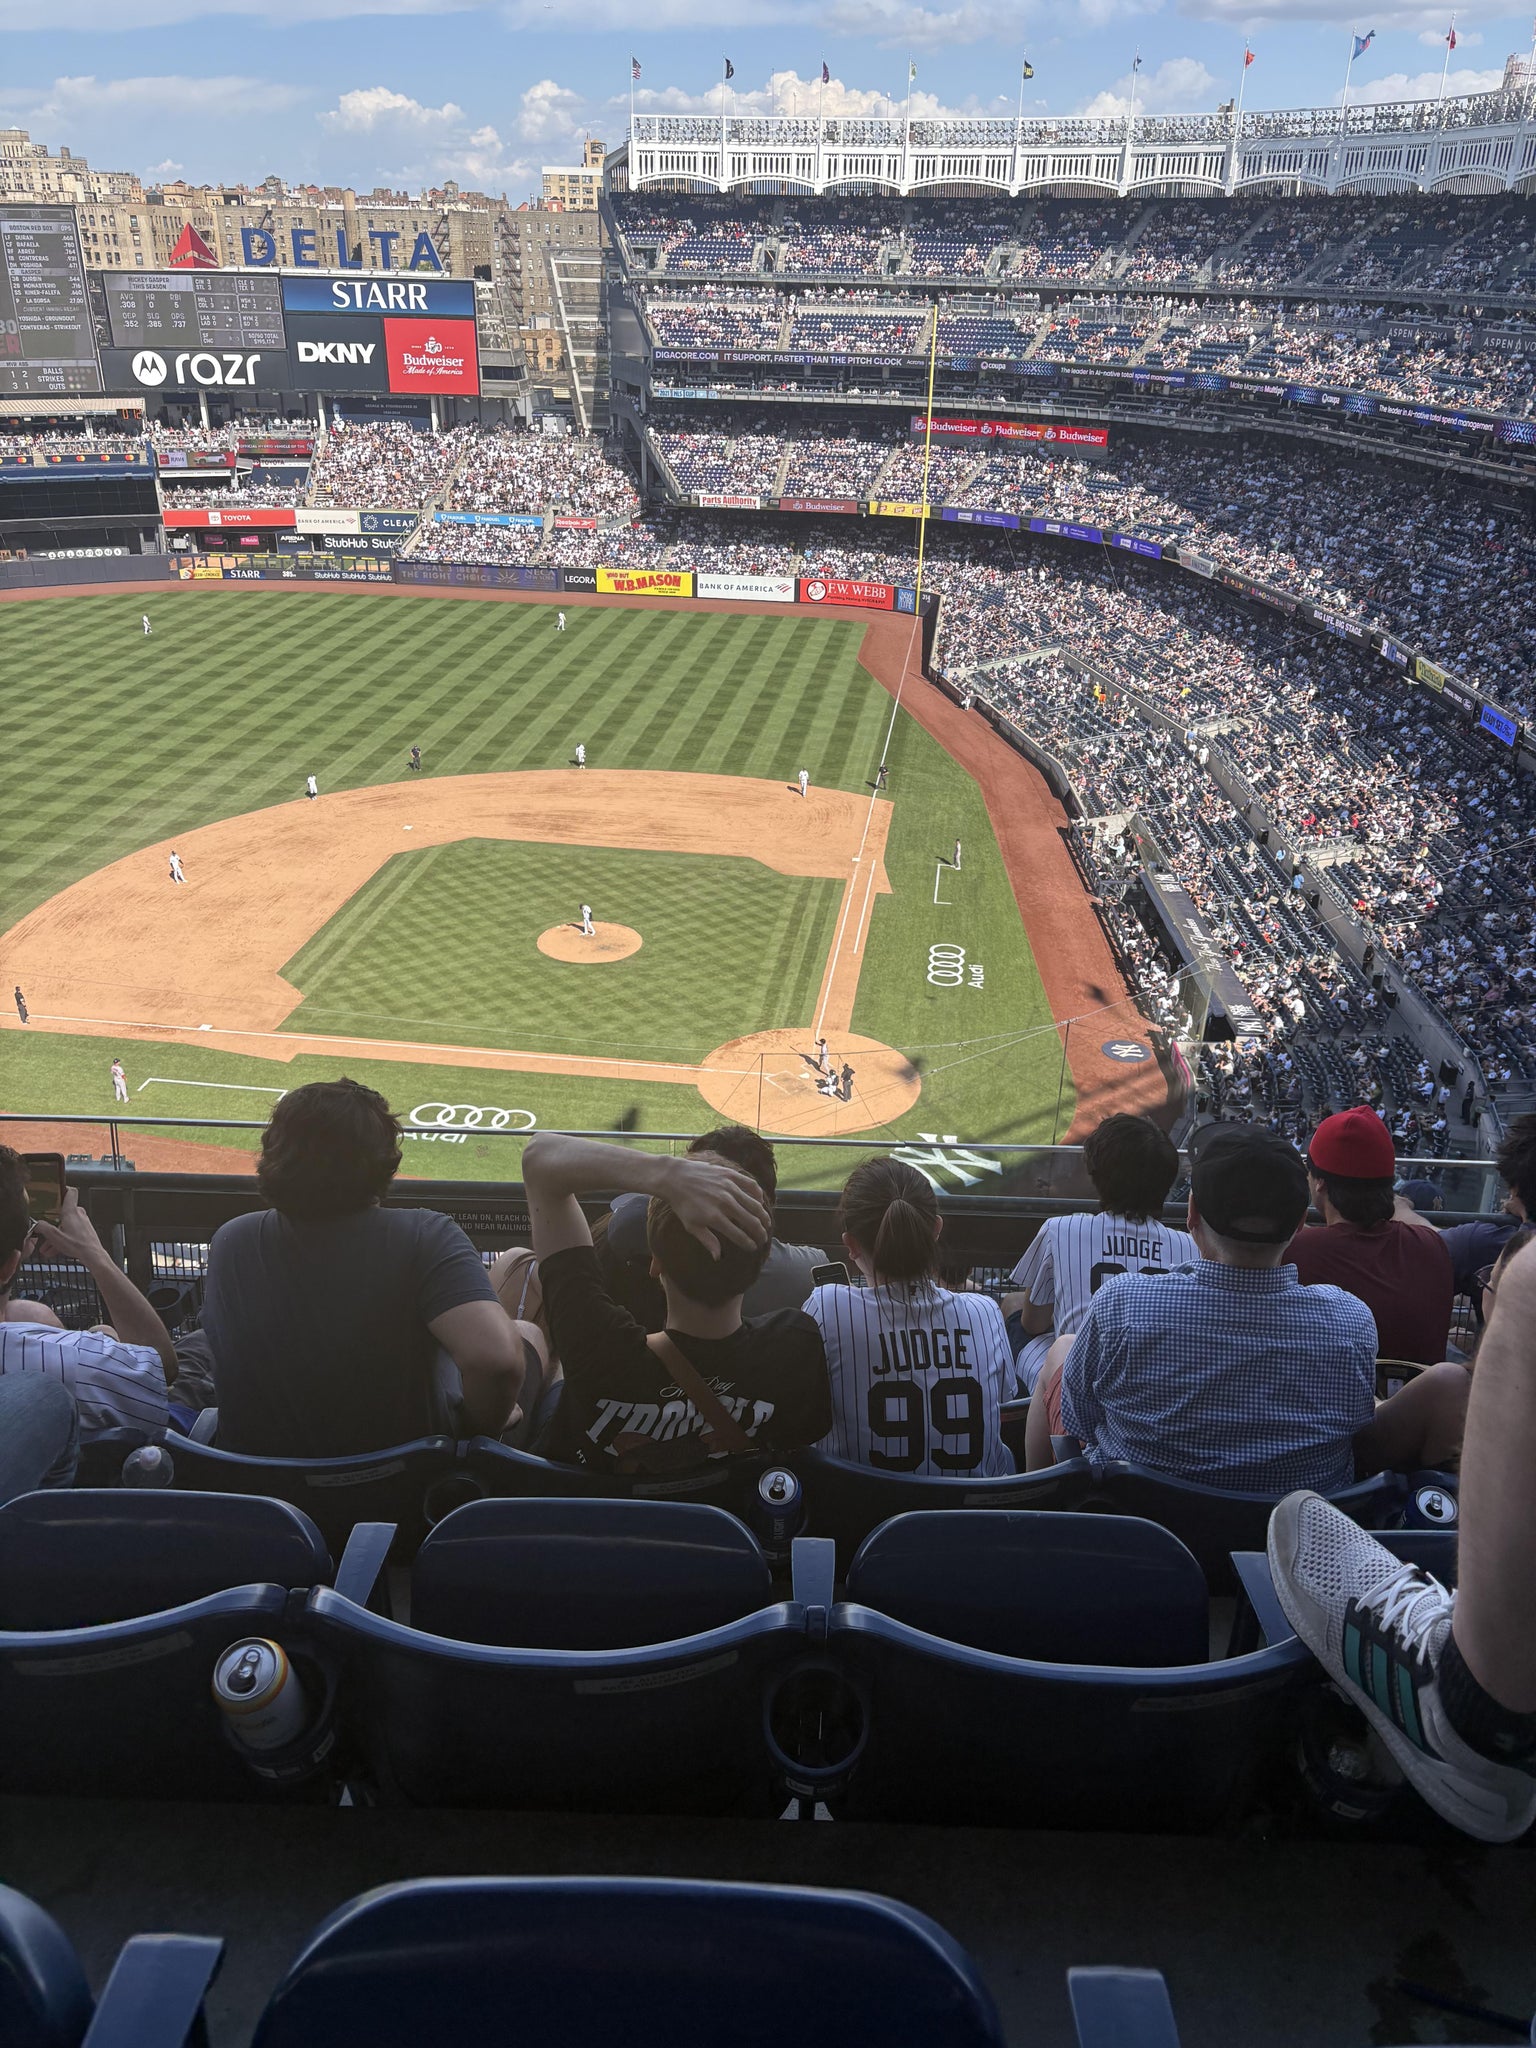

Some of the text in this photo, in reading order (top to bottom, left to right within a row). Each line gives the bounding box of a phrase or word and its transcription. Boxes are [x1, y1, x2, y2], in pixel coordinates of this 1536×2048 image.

[240, 227, 444, 271] DELTA
[332, 281, 428, 310] STARR
[1387, 328, 1414, 338] ASPEN
[1482, 337, 1514, 350] ASPEN
[297, 342, 376, 364] DKNY
[656, 351, 718, 360] DIGACORE.COM
[732, 353, 773, 362] SUPPORT,
[774, 354, 804, 363] FASTER
[806, 356, 829, 364] THAN
[830, 356, 846, 364] THE
[848, 356, 872, 365] PITCH
[874, 357, 902, 366] CLOCK
[403, 354, 464, 366] Budweiser
[175, 353, 262, 385] razr
[402, 366, 463, 376] Made of America
[1095, 370, 1120, 378] AI-native
[1134, 372, 1150, 382] spend
[1150, 374, 1185, 384] management
[930, 422, 976, 433] Budweiser
[1430, 413, 1442, 422] total
[1442, 414, 1458, 426] spend
[1458, 418, 1494, 432] management
[995, 425, 1041, 438] Budweiser
[1060, 430, 1104, 443] Budweiser
[702, 496, 757, 506] Parts Authority
[806, 503, 845, 511] Budweiser
[324, 538, 368, 548] StubHub
[230, 570, 260, 578] STARR
[342, 572, 366, 580] StubHub
[368, 573, 392, 581] StubHub
[456, 574, 492, 582] CHOICE
[564, 575, 596, 584] LEGORA
[736, 585, 774, 593] AMERICA
[828, 582, 886, 599] F.W. WEBB
[968, 964, 984, 990] Audi
[497, 1224, 532, 1232] RAILINGS
[1102, 1235, 1164, 1262] JUDGE
[872, 1328, 972, 1376] JUDGE
[868, 1376, 984, 1472] 99
